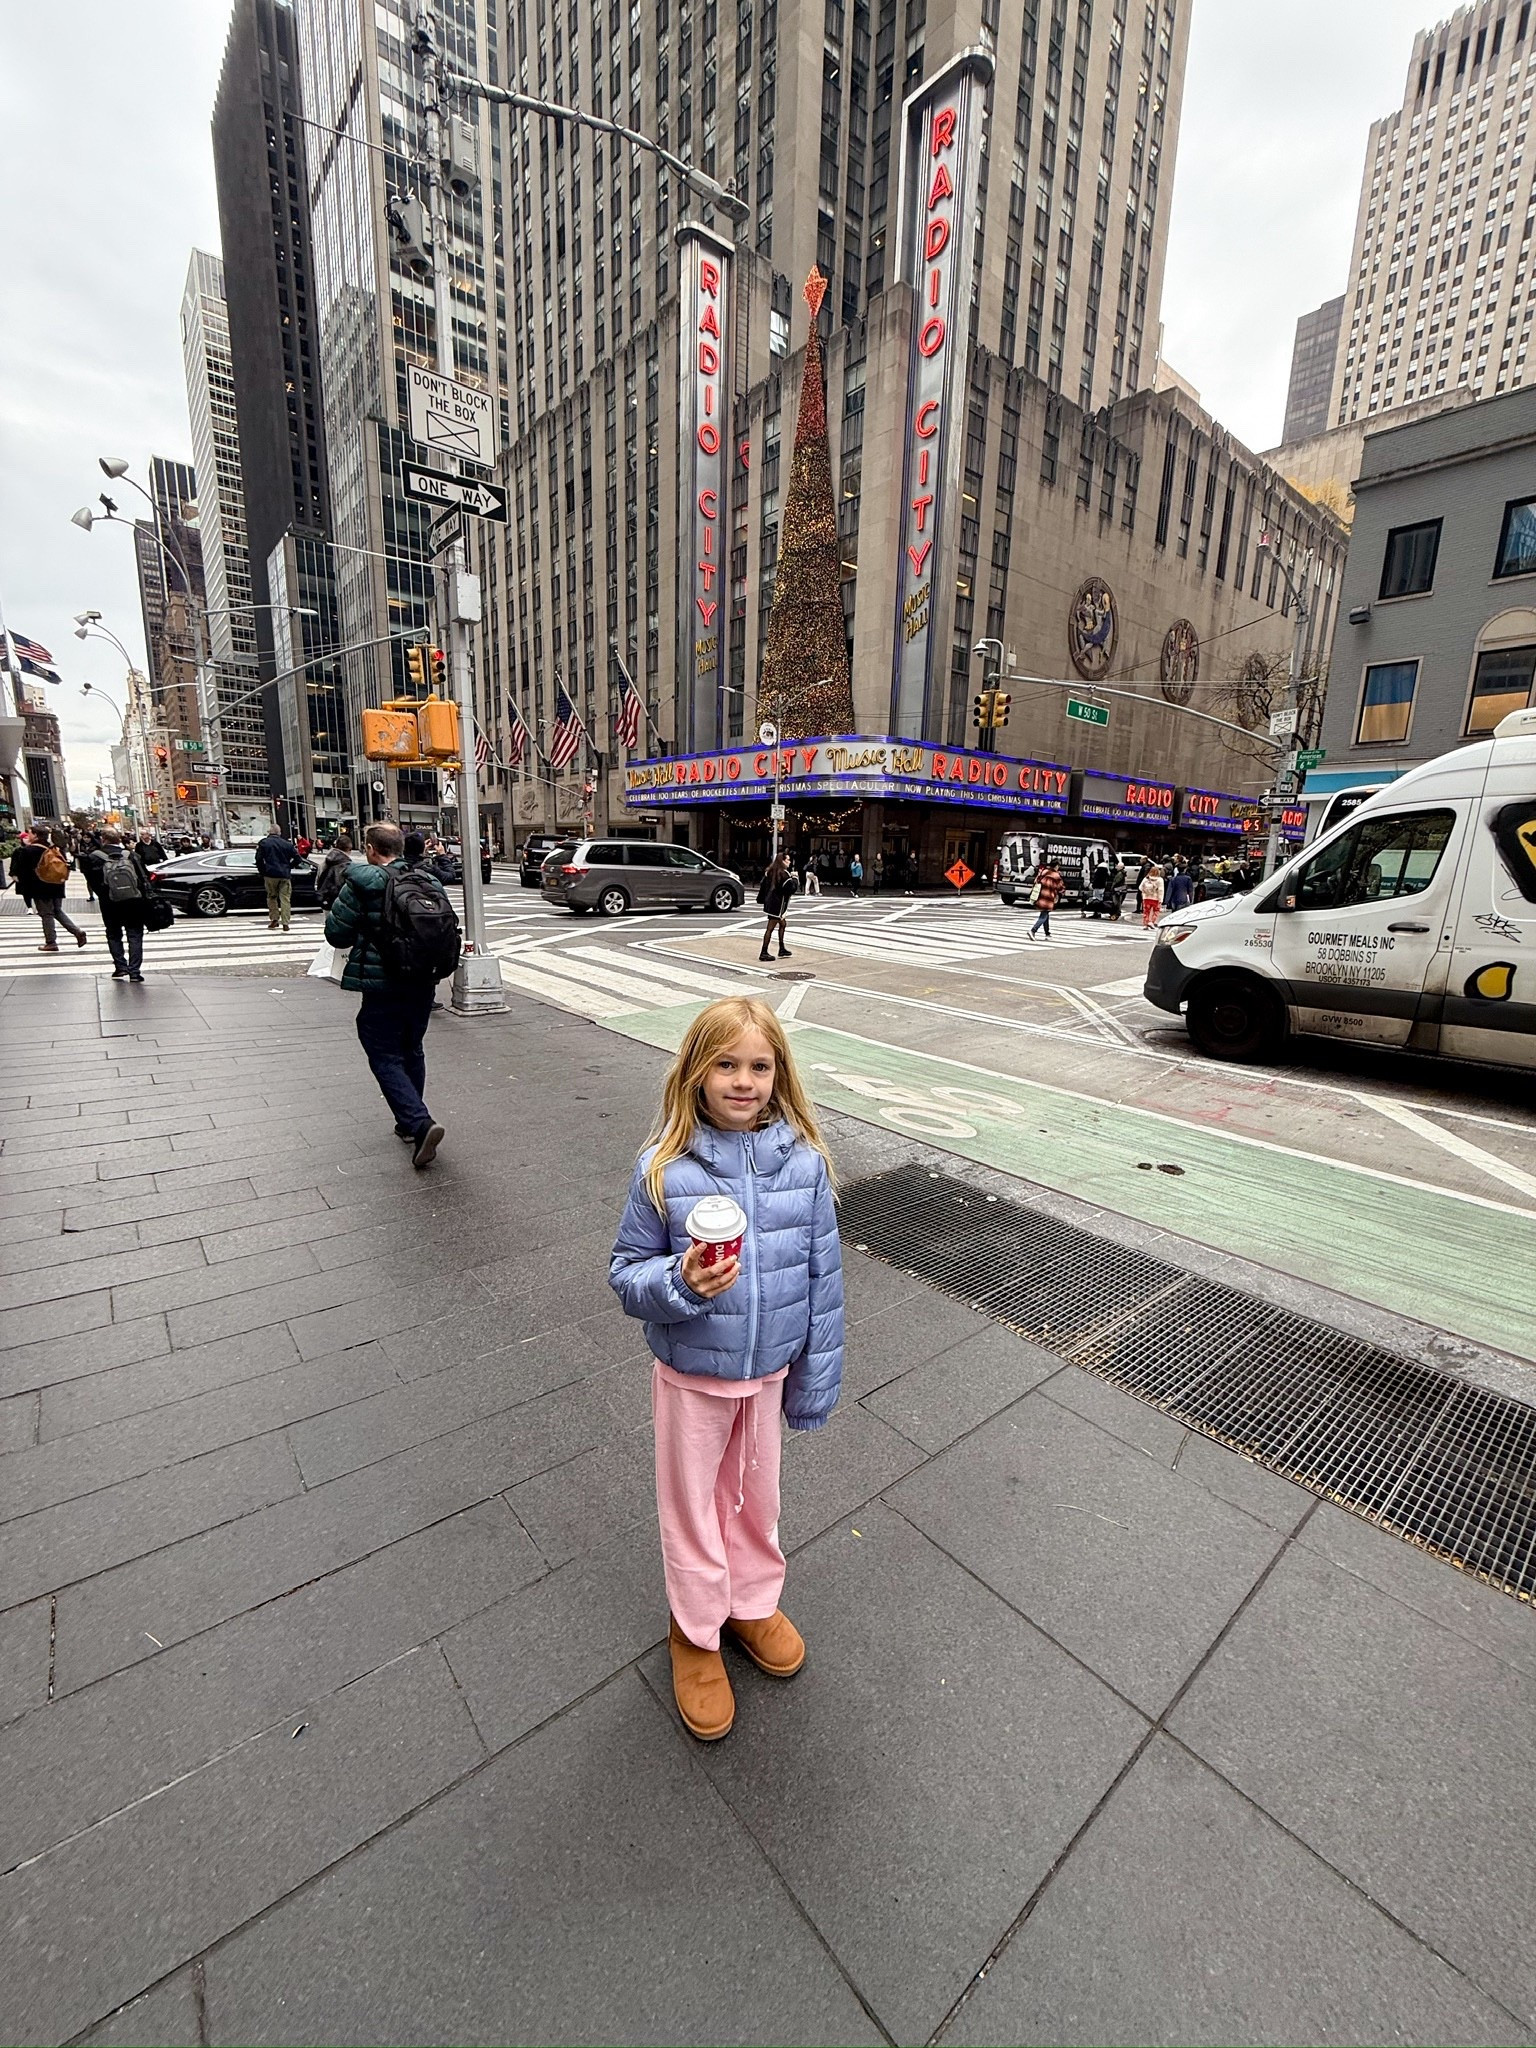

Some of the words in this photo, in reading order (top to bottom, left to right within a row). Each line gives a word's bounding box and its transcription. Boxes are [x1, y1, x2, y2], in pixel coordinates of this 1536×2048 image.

[918, 106, 956, 357] RADIO
[698, 259, 721, 453] RADIO
[414, 372, 447, 396] DON'T
[452, 386, 488, 412] BLOCK
[428, 394, 450, 414] THE
[455, 404, 476, 424] BOX
[418, 477, 449, 497] ONE
[462, 488, 491, 508] WAY
[908, 400, 939, 576] CITY
[697, 489, 717, 626] CITY
[1078, 705, 1084, 716] W
[1083, 707, 1091, 718] 50
[675, 755, 741, 784] RADIO
[753, 746, 819, 777] CITY
[825, 747, 887, 773] Music
[881, 747, 925, 775] Hall
[932, 753, 1008, 786] RADIO
[1019, 766, 1067, 794] CITY
[1300, 761, 1305, 769] 6
[629, 793, 656, 802] CELEBRATE
[671, 790, 688, 799] YEARS
[691, 790, 699, 798] OF
[703, 787, 738, 798] ROCKETTES
[741, 787, 749, 795] AT
[771, 781, 812, 793] RISTMAS
[905, 784, 921, 793] NOW
[925, 786, 956, 798] PLAYING
[960, 790, 974, 800] THIS
[977, 792, 984, 800] IS
[987, 793, 1021, 805] CHRISTMAS
[1024, 797, 1030, 805] IN
[1033, 798, 1044, 807] NEW
[1047, 800, 1061, 809] YORK
[1126, 784, 1172, 808] RADIO
[1189, 794, 1219, 815] CITY
[1083, 804, 1110, 815] CELEBRATE
[1281, 810, 1303, 826] ADIO
[1254, 819, 1260, 831] 5
[1047, 844, 1082, 856] HOBOKEN
[1244, 939, 1272, 948] 265530
[1308, 931, 1349, 947] GOURMET
[1349, 934, 1379, 949] MEALS
[1379, 936, 1396, 950] INC
[1317, 947, 1327, 960] 58
[1328, 948, 1364, 963] DOBBINS
[1365, 951, 1378, 964] ST
[1305, 961, 1349, 977] BROOKLYN
[1349, 965, 1362, 978] NY
[1363, 966, 1386, 981] 11205
[1318, 975, 1342, 984] USDOT
[1343, 977, 1371, 987] 4357173
[1321, 1014, 1342, 1024] GVW
[1343, 1016, 1363, 1026] 8500
